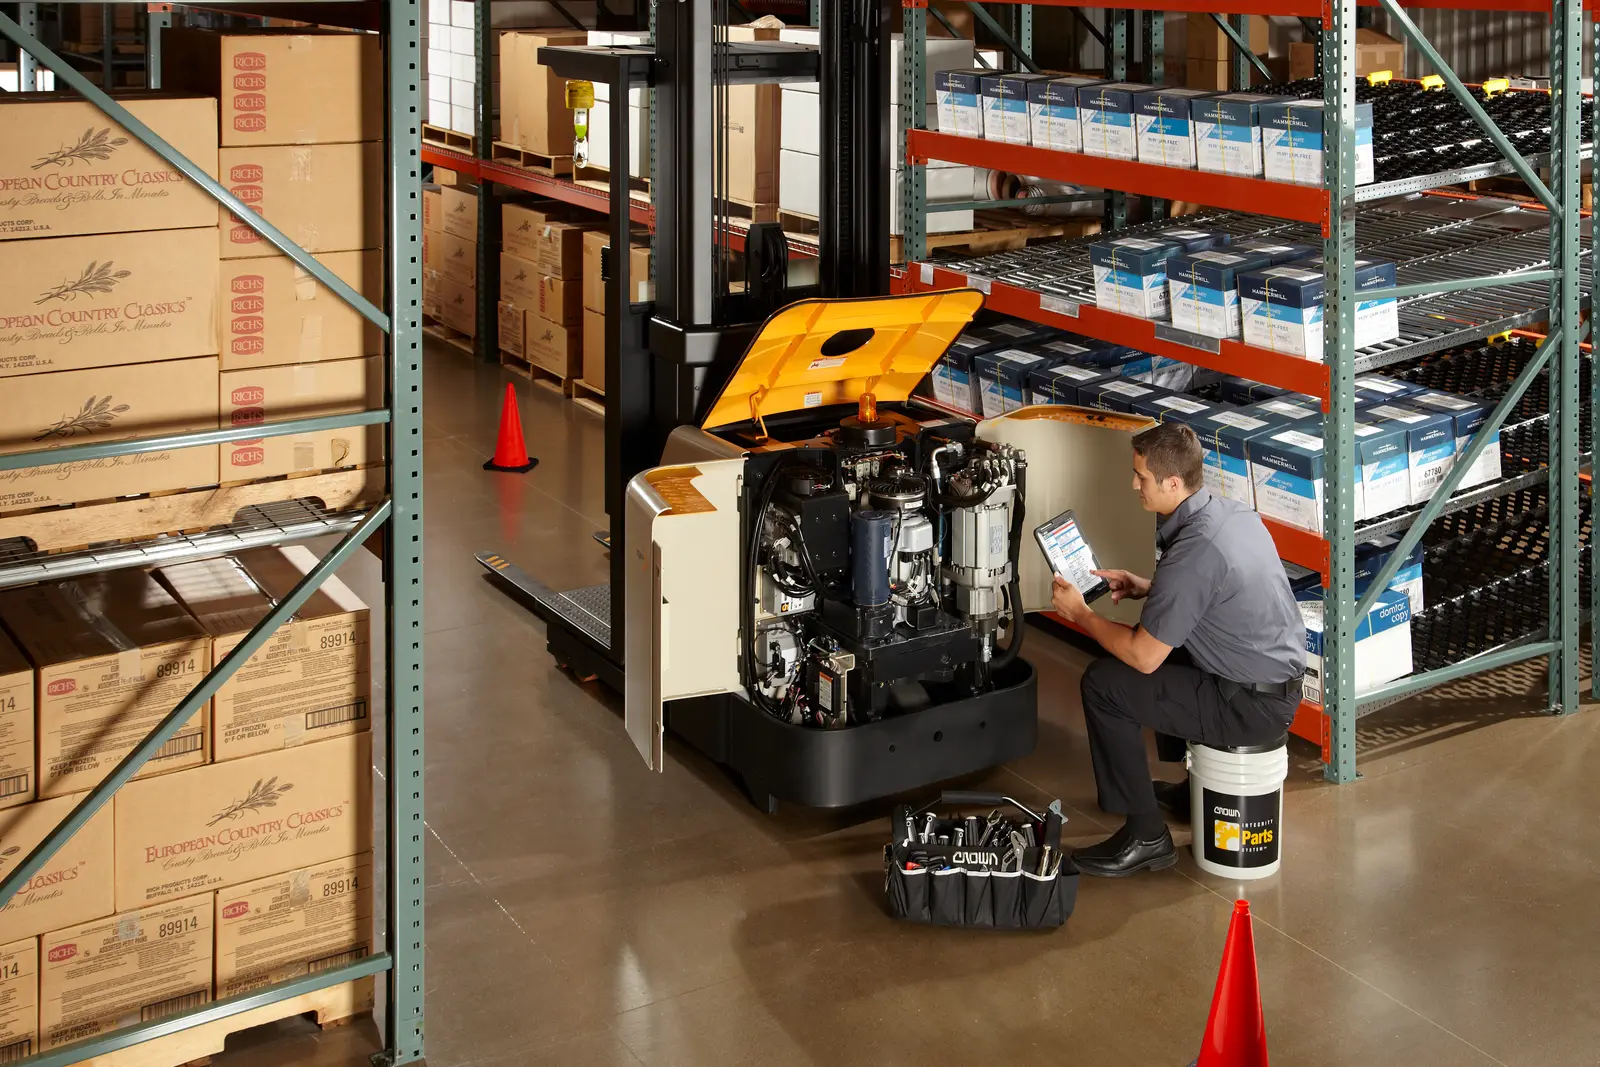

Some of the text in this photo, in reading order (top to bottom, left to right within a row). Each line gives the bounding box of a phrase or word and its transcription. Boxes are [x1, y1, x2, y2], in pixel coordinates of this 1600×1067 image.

[1144, 104, 1174, 113] HAMMERMILL
[1204, 112, 1236, 121] HAMMERMILL
[1272, 118, 1309, 127] HAMMERMILL
[44, 172, 119, 190] COUNTRY
[73, 189, 105, 203] Rolls
[124, 187, 169, 200] Minutes
[1100, 257, 1130, 269] HAMMERMILL
[1178, 271, 1210, 284] HAMMERMILL
[1251, 288, 1288, 301] HAMMERMILL
[47, 307, 120, 327] COUNTRY
[75, 323, 106, 336] Rolls
[127, 319, 172, 331] Minutes
[1197, 434, 1230, 449] HAMMEMILL
[125, 453, 172, 466] Minutes
[1261, 455, 1298, 471] HAMMERMILL
[1424, 466, 1442, 477] 67780
[1391, 609, 1409, 623] copy
[320, 631, 356, 649] 89914
[156, 659, 195, 678] 89914
[224, 723, 267, 737] KEEP FROZEN
[247, 728, 270, 738] BELOW
[50, 762, 68, 771] KEEP
[68, 756, 97, 767] FROZEN
[74, 762, 100, 773] BELOW
[1213, 806, 1240, 817] CROWN
[1241, 819, 1274, 828] INTEGRITY
[144, 805, 343, 863] EUROPEAN COUNTRY CLASSICS
[1241, 829, 1273, 845] Parts
[162, 856, 196, 870] Crusty
[288, 824, 330, 841] Minutes
[952, 851, 998, 866] CROWN
[161, 878, 191, 890] PRODUCTS
[192, 874, 209, 883] CORP.
[323, 877, 358, 897] 89914
[159, 916, 198, 938] 89914
[50, 1020, 99, 1038] KEEP FROZEN
[65, 1034, 75, 1042] OR
[76, 1027, 101, 1038] BELOW
